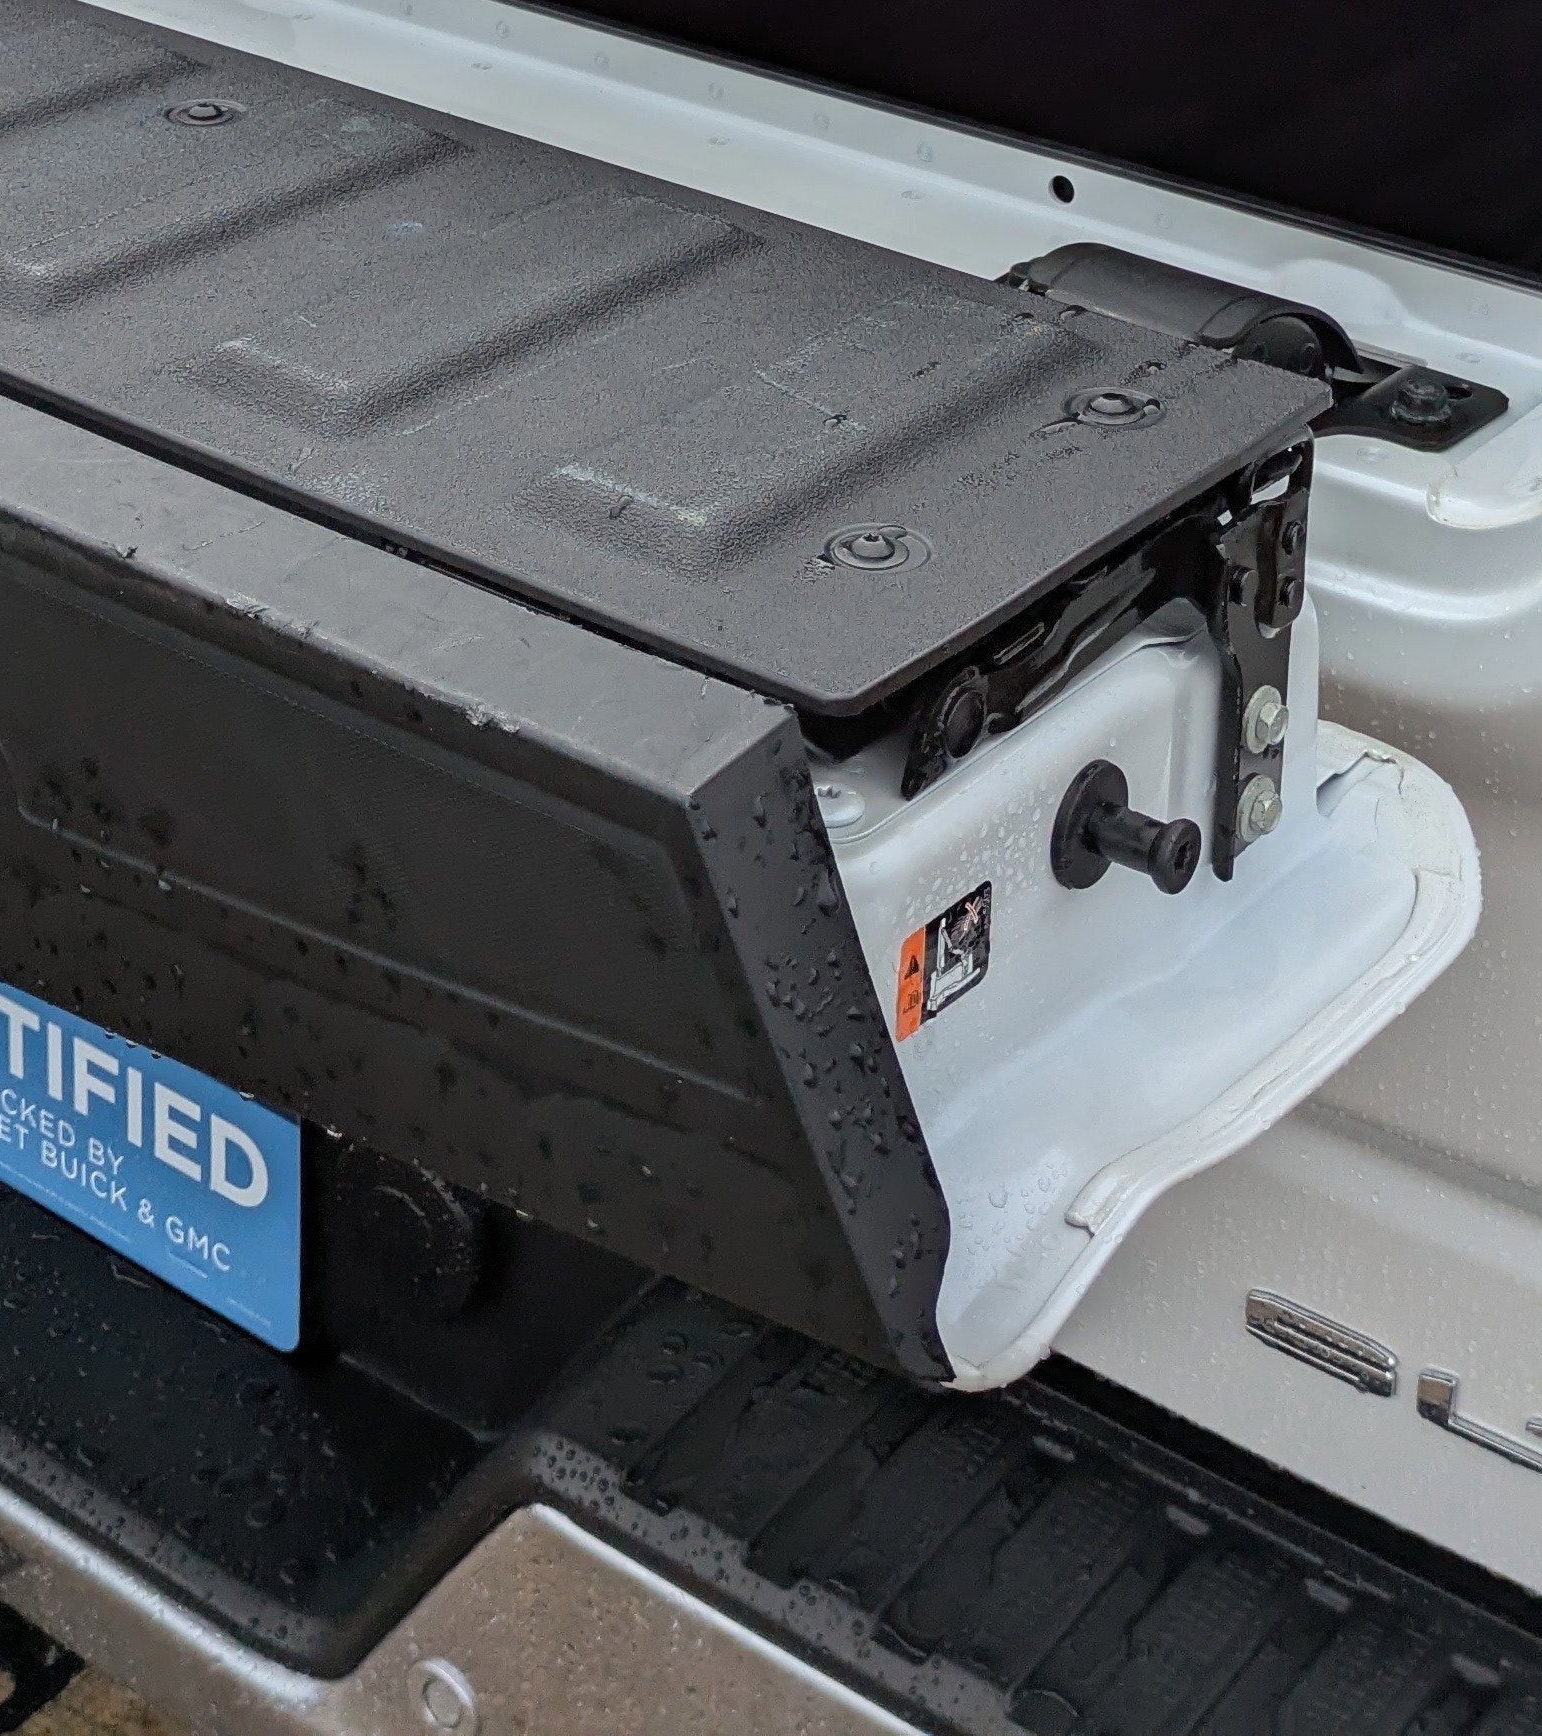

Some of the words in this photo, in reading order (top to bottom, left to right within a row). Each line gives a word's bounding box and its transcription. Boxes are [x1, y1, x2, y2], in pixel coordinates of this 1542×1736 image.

[88, 1137, 124, 1175] BY
[41, 1140, 127, 1211] BUICK
[137, 1198, 154, 1228] &
[165, 1216, 231, 1271] GMC
